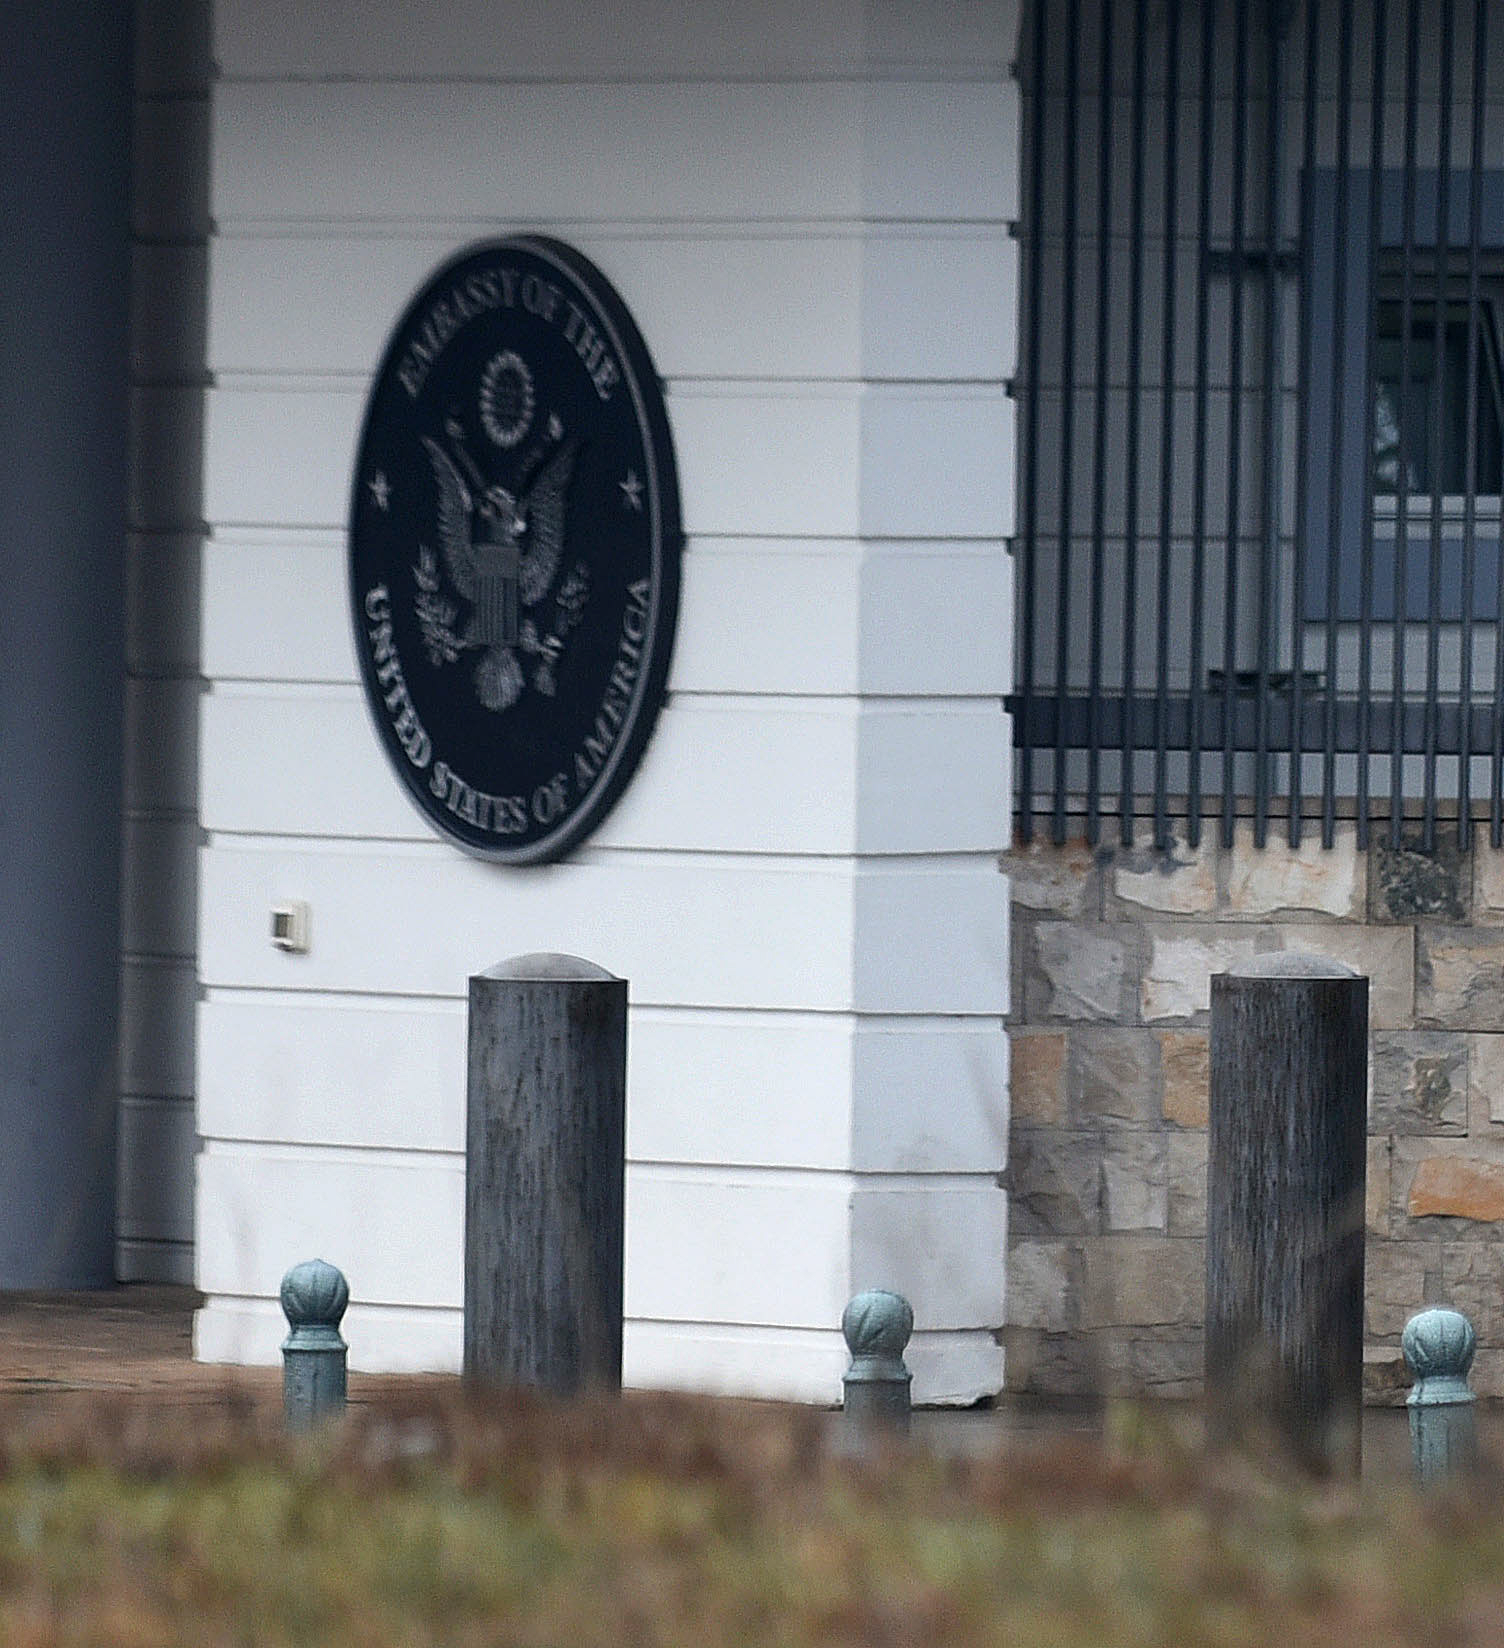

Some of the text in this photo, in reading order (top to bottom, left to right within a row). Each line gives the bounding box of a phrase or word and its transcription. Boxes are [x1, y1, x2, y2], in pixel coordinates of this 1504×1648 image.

[398, 268, 619, 401] EMBASSY OF THE
[365, 579, 651, 834] UNITED STATES OF AMERICA
